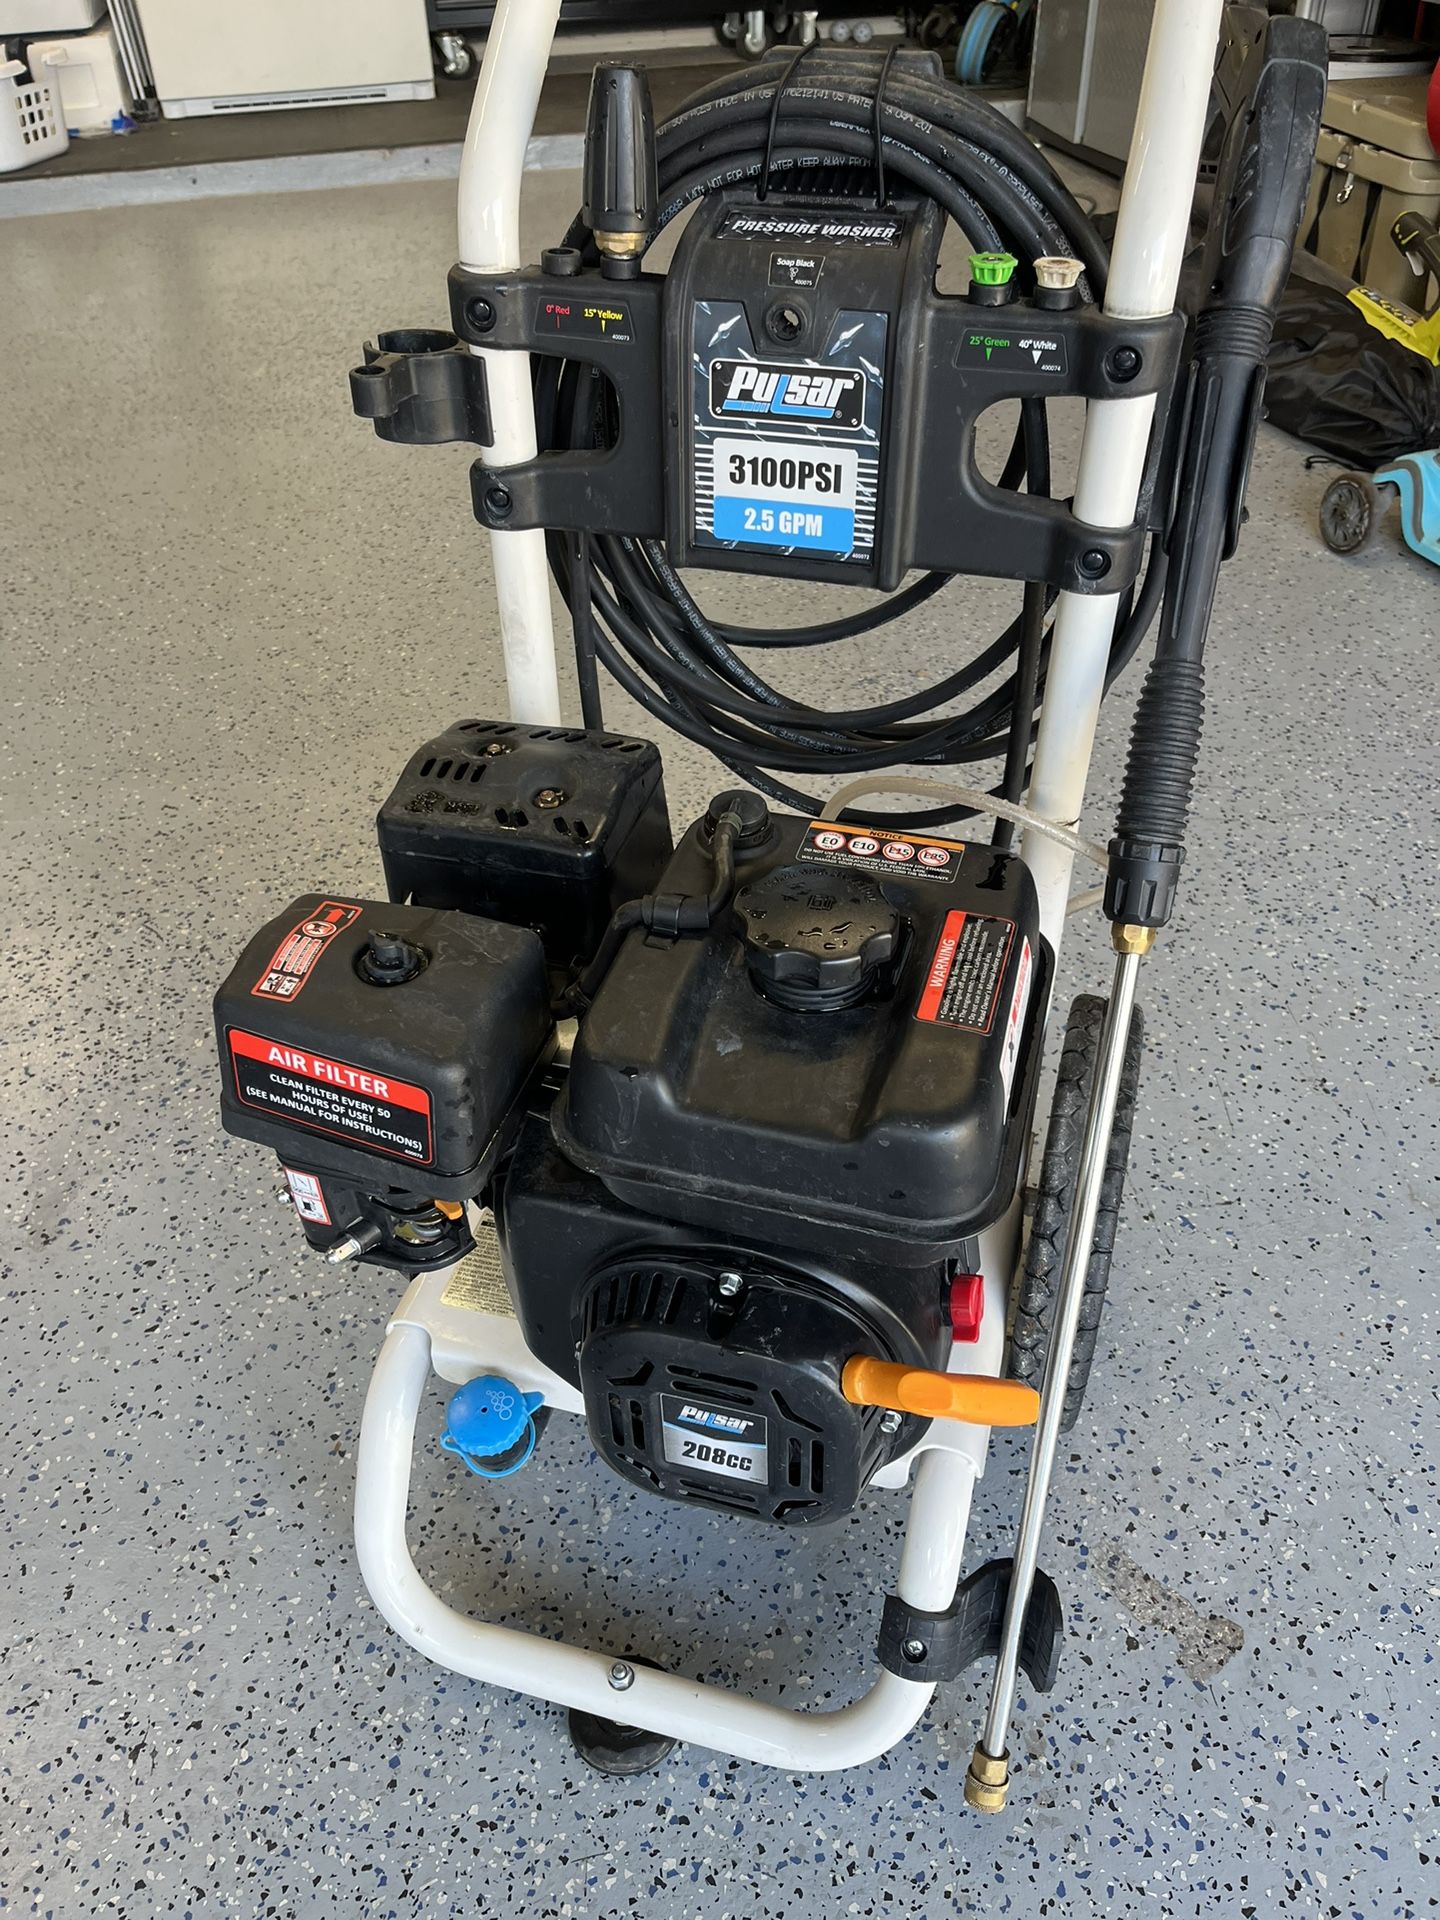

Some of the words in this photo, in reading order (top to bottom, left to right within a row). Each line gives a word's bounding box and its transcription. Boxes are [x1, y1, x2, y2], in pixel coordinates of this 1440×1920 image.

[726, 170, 743, 183] FOR
[746, 163, 762, 177] HOT
[797, 156, 819, 167] KEEP
[732, 219, 819, 236] PRESSURE
[821, 223, 896, 240] WASHER
[776, 257, 795, 268] Soap
[796, 258, 815, 268] Black
[555, 305, 571, 315] Red
[597, 310, 623, 321] Yellow
[984, 336, 1010, 347] Green
[1033, 340, 1057, 351] White
[729, 454, 843, 494] 3100PSI
[744, 507, 774, 532] 2.5
[778, 512, 823, 537] GPM
[821, 836, 838, 845] E0
[851, 841, 875, 850] E10
[869, 830, 903, 840] NOTICE
[929, 938, 956, 988] WARNING
[981, 990, 990, 1009] Owner's
[986, 973, 995, 989] Manual
[991, 957, 999, 971] before
[941, 994, 951, 1014] Gasoline
[268, 1046, 308, 1075] AIR
[312, 1057, 390, 1098] FILTER
[270, 1073, 304, 1092] CLEAN
[305, 1084, 340, 1103] FILTER
[341, 1095, 376, 1114] EVERY
[377, 1107, 391, 1119] 50
[292, 1089, 330, 1110] HOURS
[331, 1102, 347, 1115] OF
[348, 1108, 374, 1124] USE!
[245, 1085, 269, 1101] (SEE
[269, 1092, 317, 1117] MANUAL
[318, 1108, 340, 1124] FOR
[341, 1116, 423, 1152] INSTRUCTIONS)
